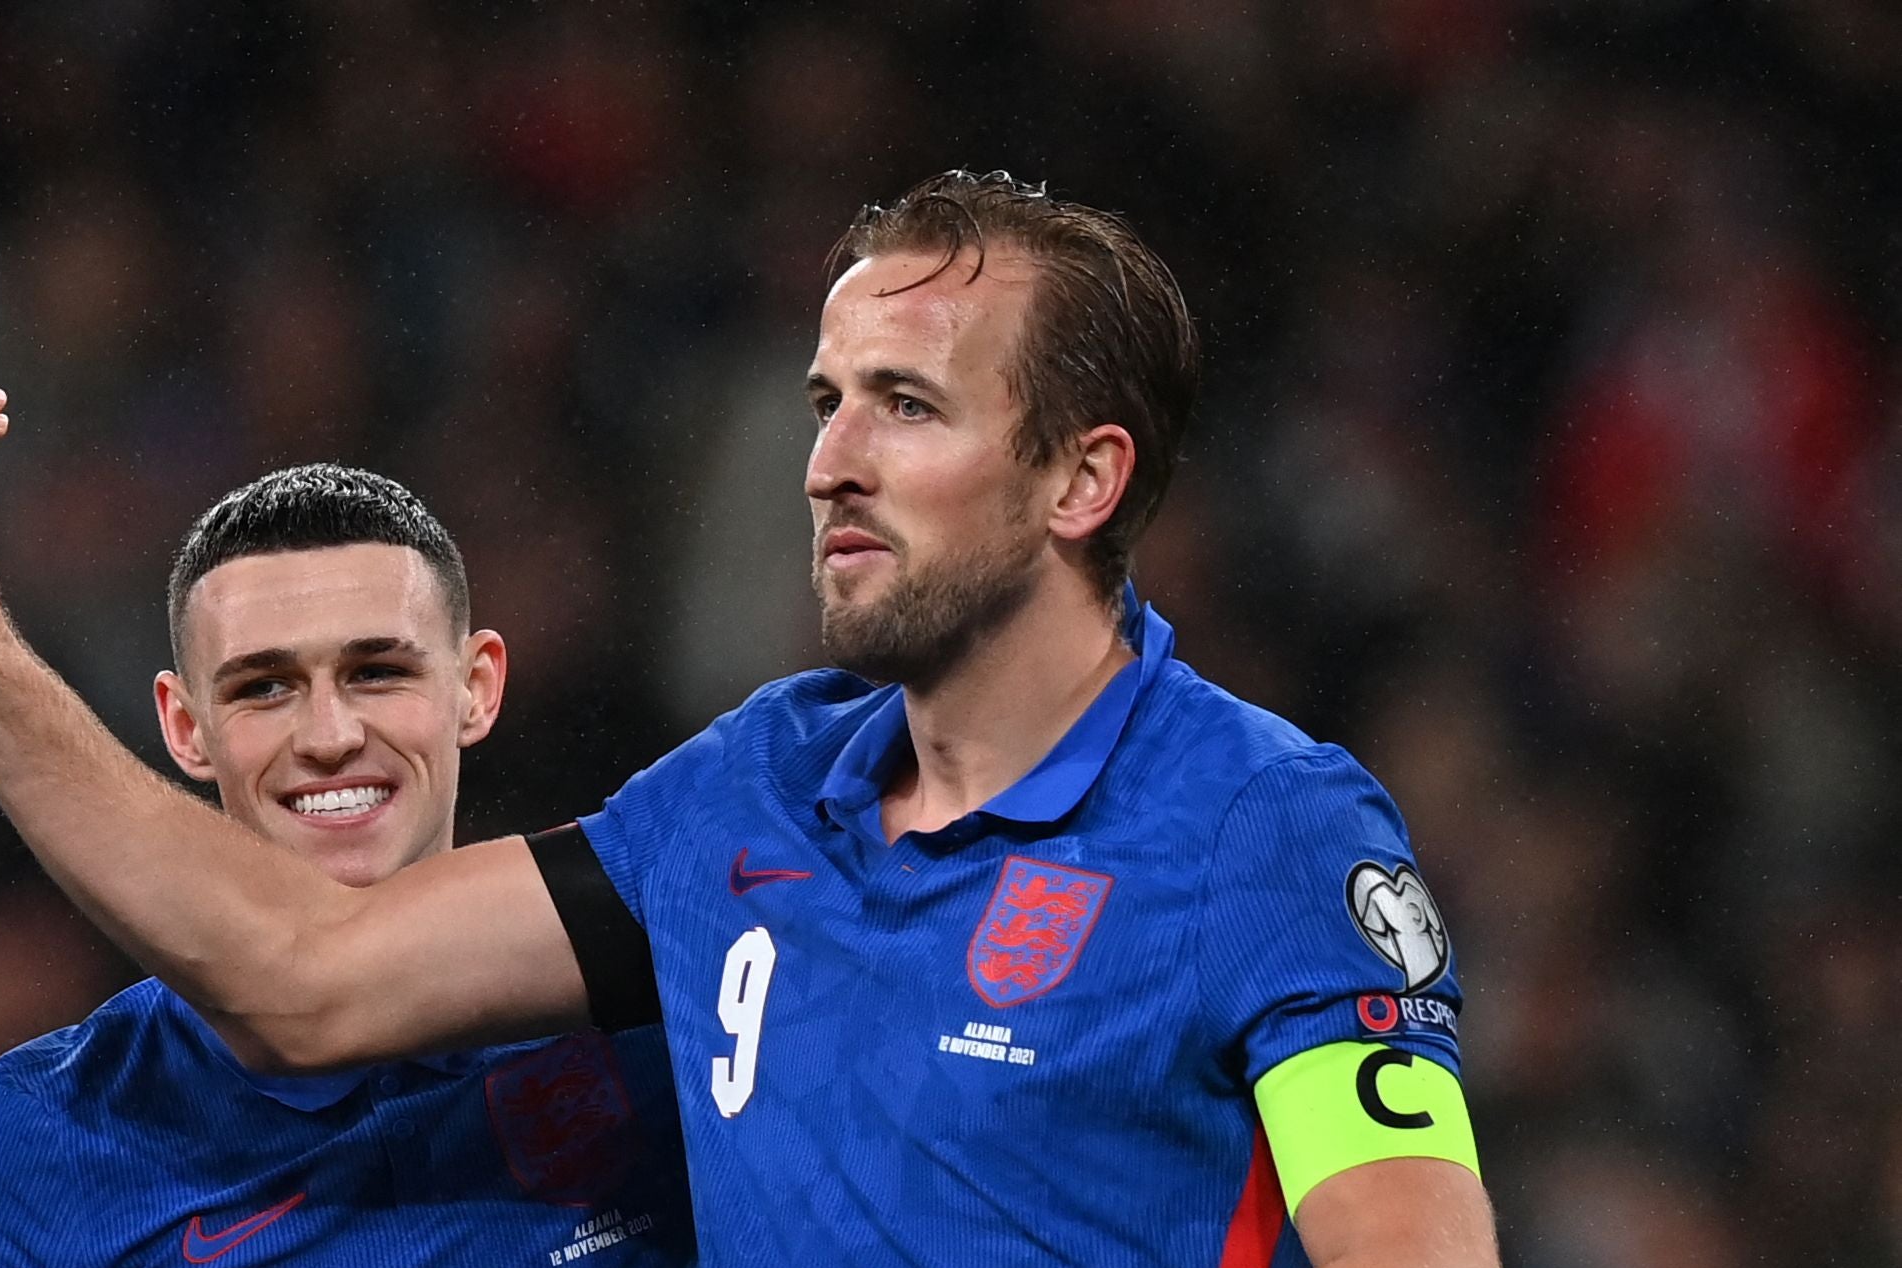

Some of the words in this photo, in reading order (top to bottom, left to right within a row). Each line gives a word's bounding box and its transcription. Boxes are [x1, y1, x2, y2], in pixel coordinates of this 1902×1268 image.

[711, 926, 777, 1118] 9
[963, 1021, 1011, 1043] ALBANIA
[938, 1035, 950, 1052] 12
[949, 1037, 1006, 1062] NOVEMBER
[1008, 1047, 1035, 1066] 2021
[1356, 1048, 1434, 1129] C
[549, 1250, 562, 1267] 12
[564, 1226, 626, 1262] NOVEMBER
[628, 1214, 654, 1235] 2021
[574, 1209, 622, 1240] ALBANIA
